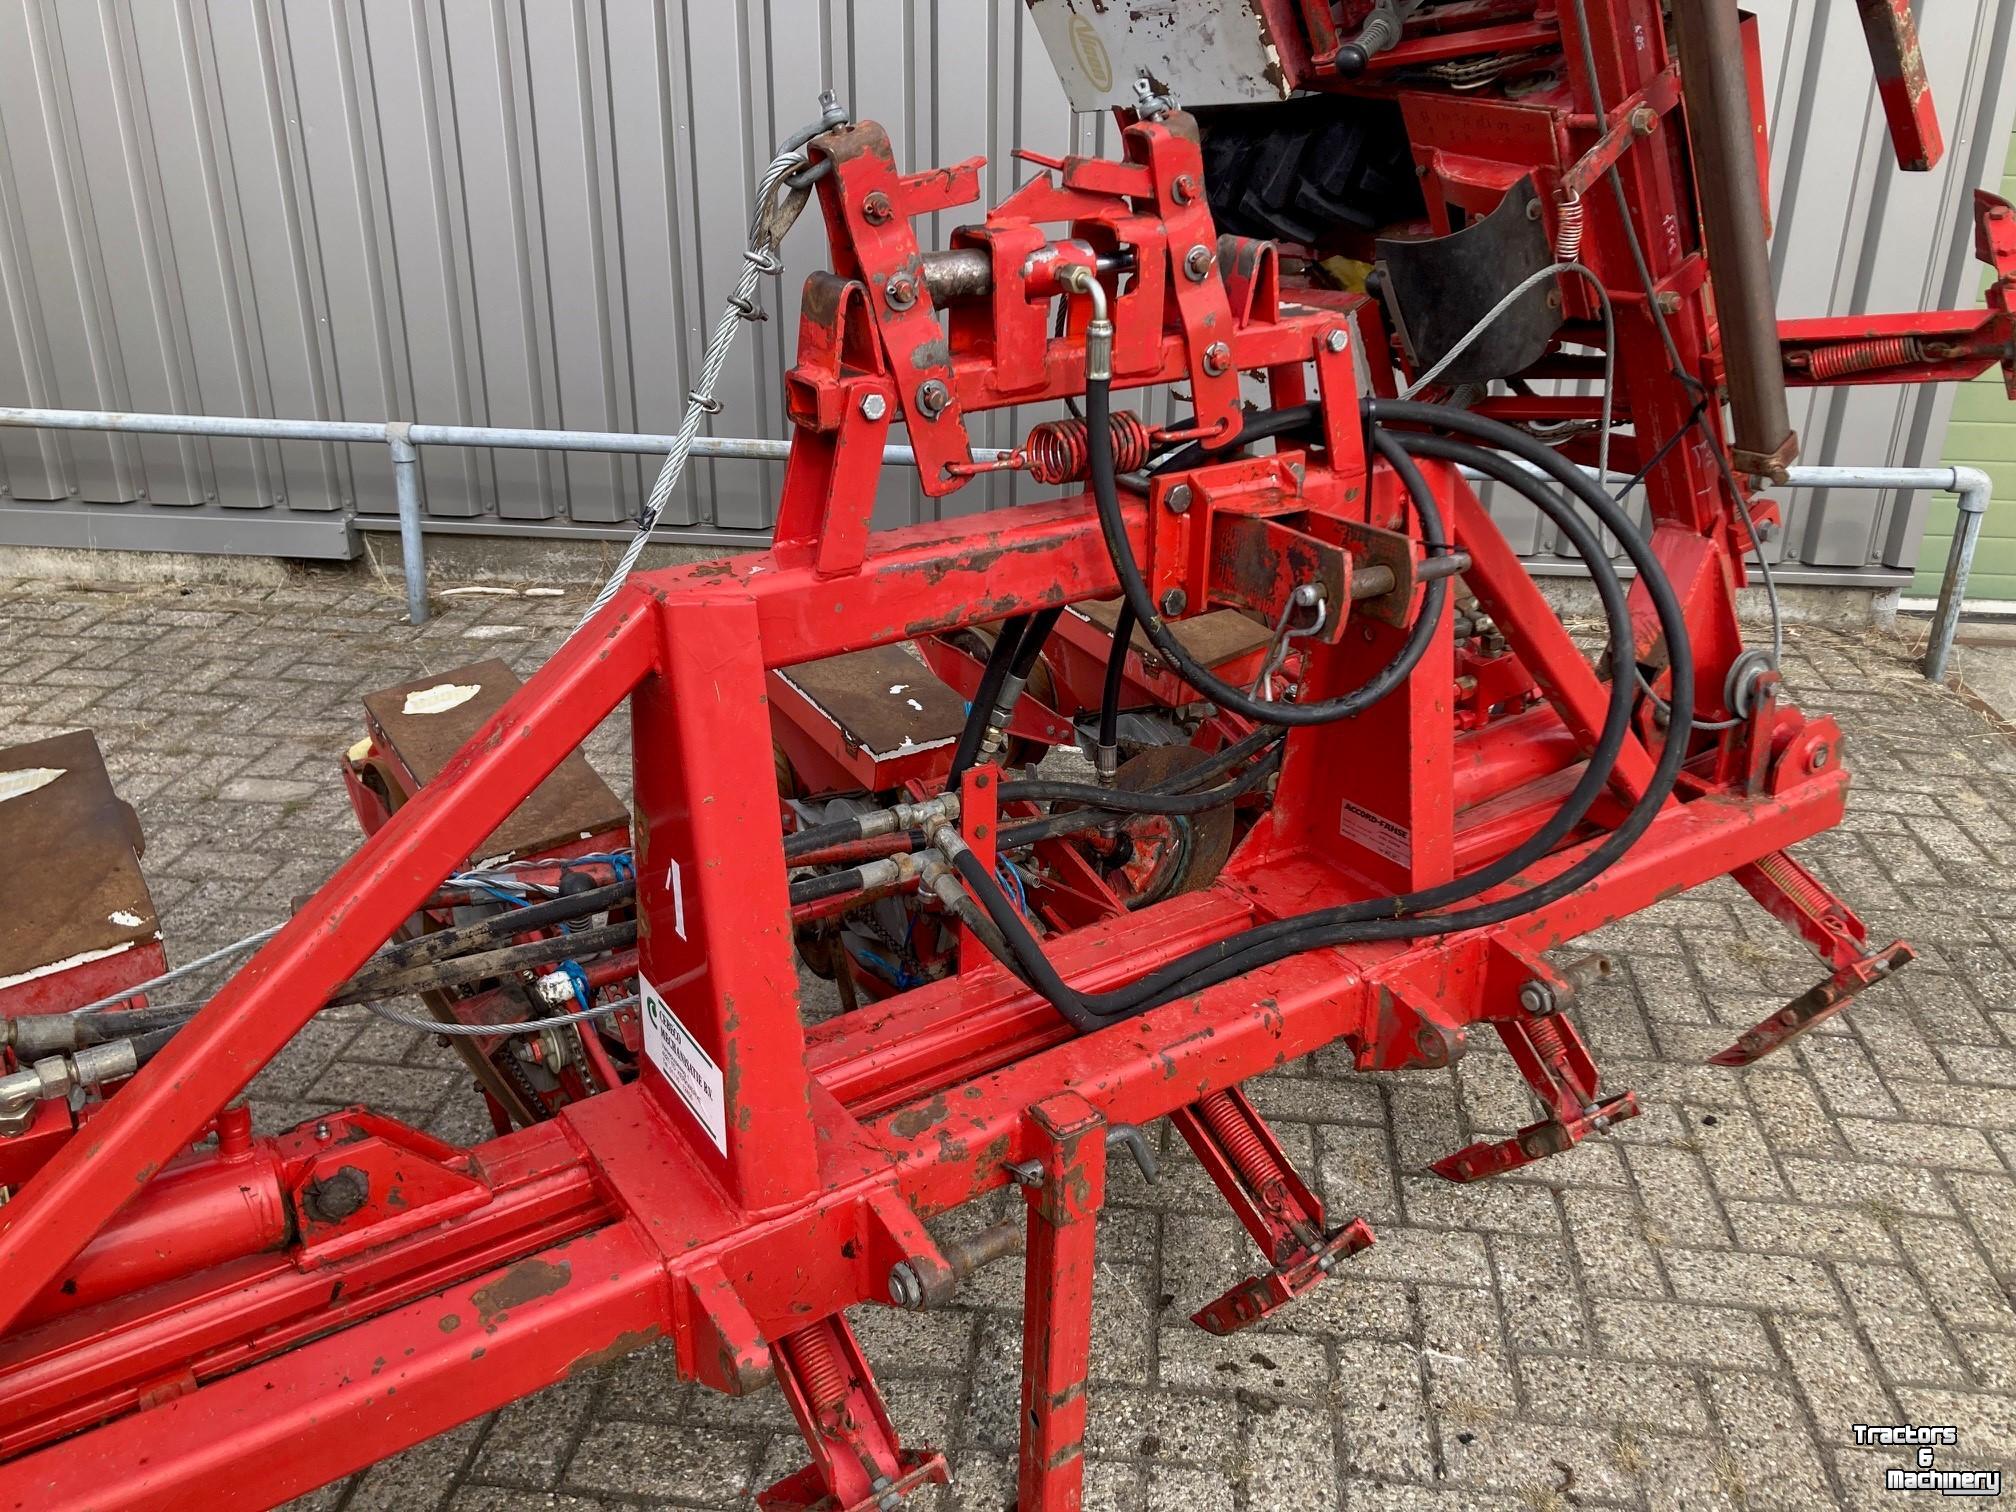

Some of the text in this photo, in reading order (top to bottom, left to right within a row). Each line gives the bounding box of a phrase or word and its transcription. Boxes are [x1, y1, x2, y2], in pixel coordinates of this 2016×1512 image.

[665, 858, 687, 942] 1
[659, 1010, 682, 1044] CEBECO
[660, 1025, 703, 1087] MECHANISATIE
